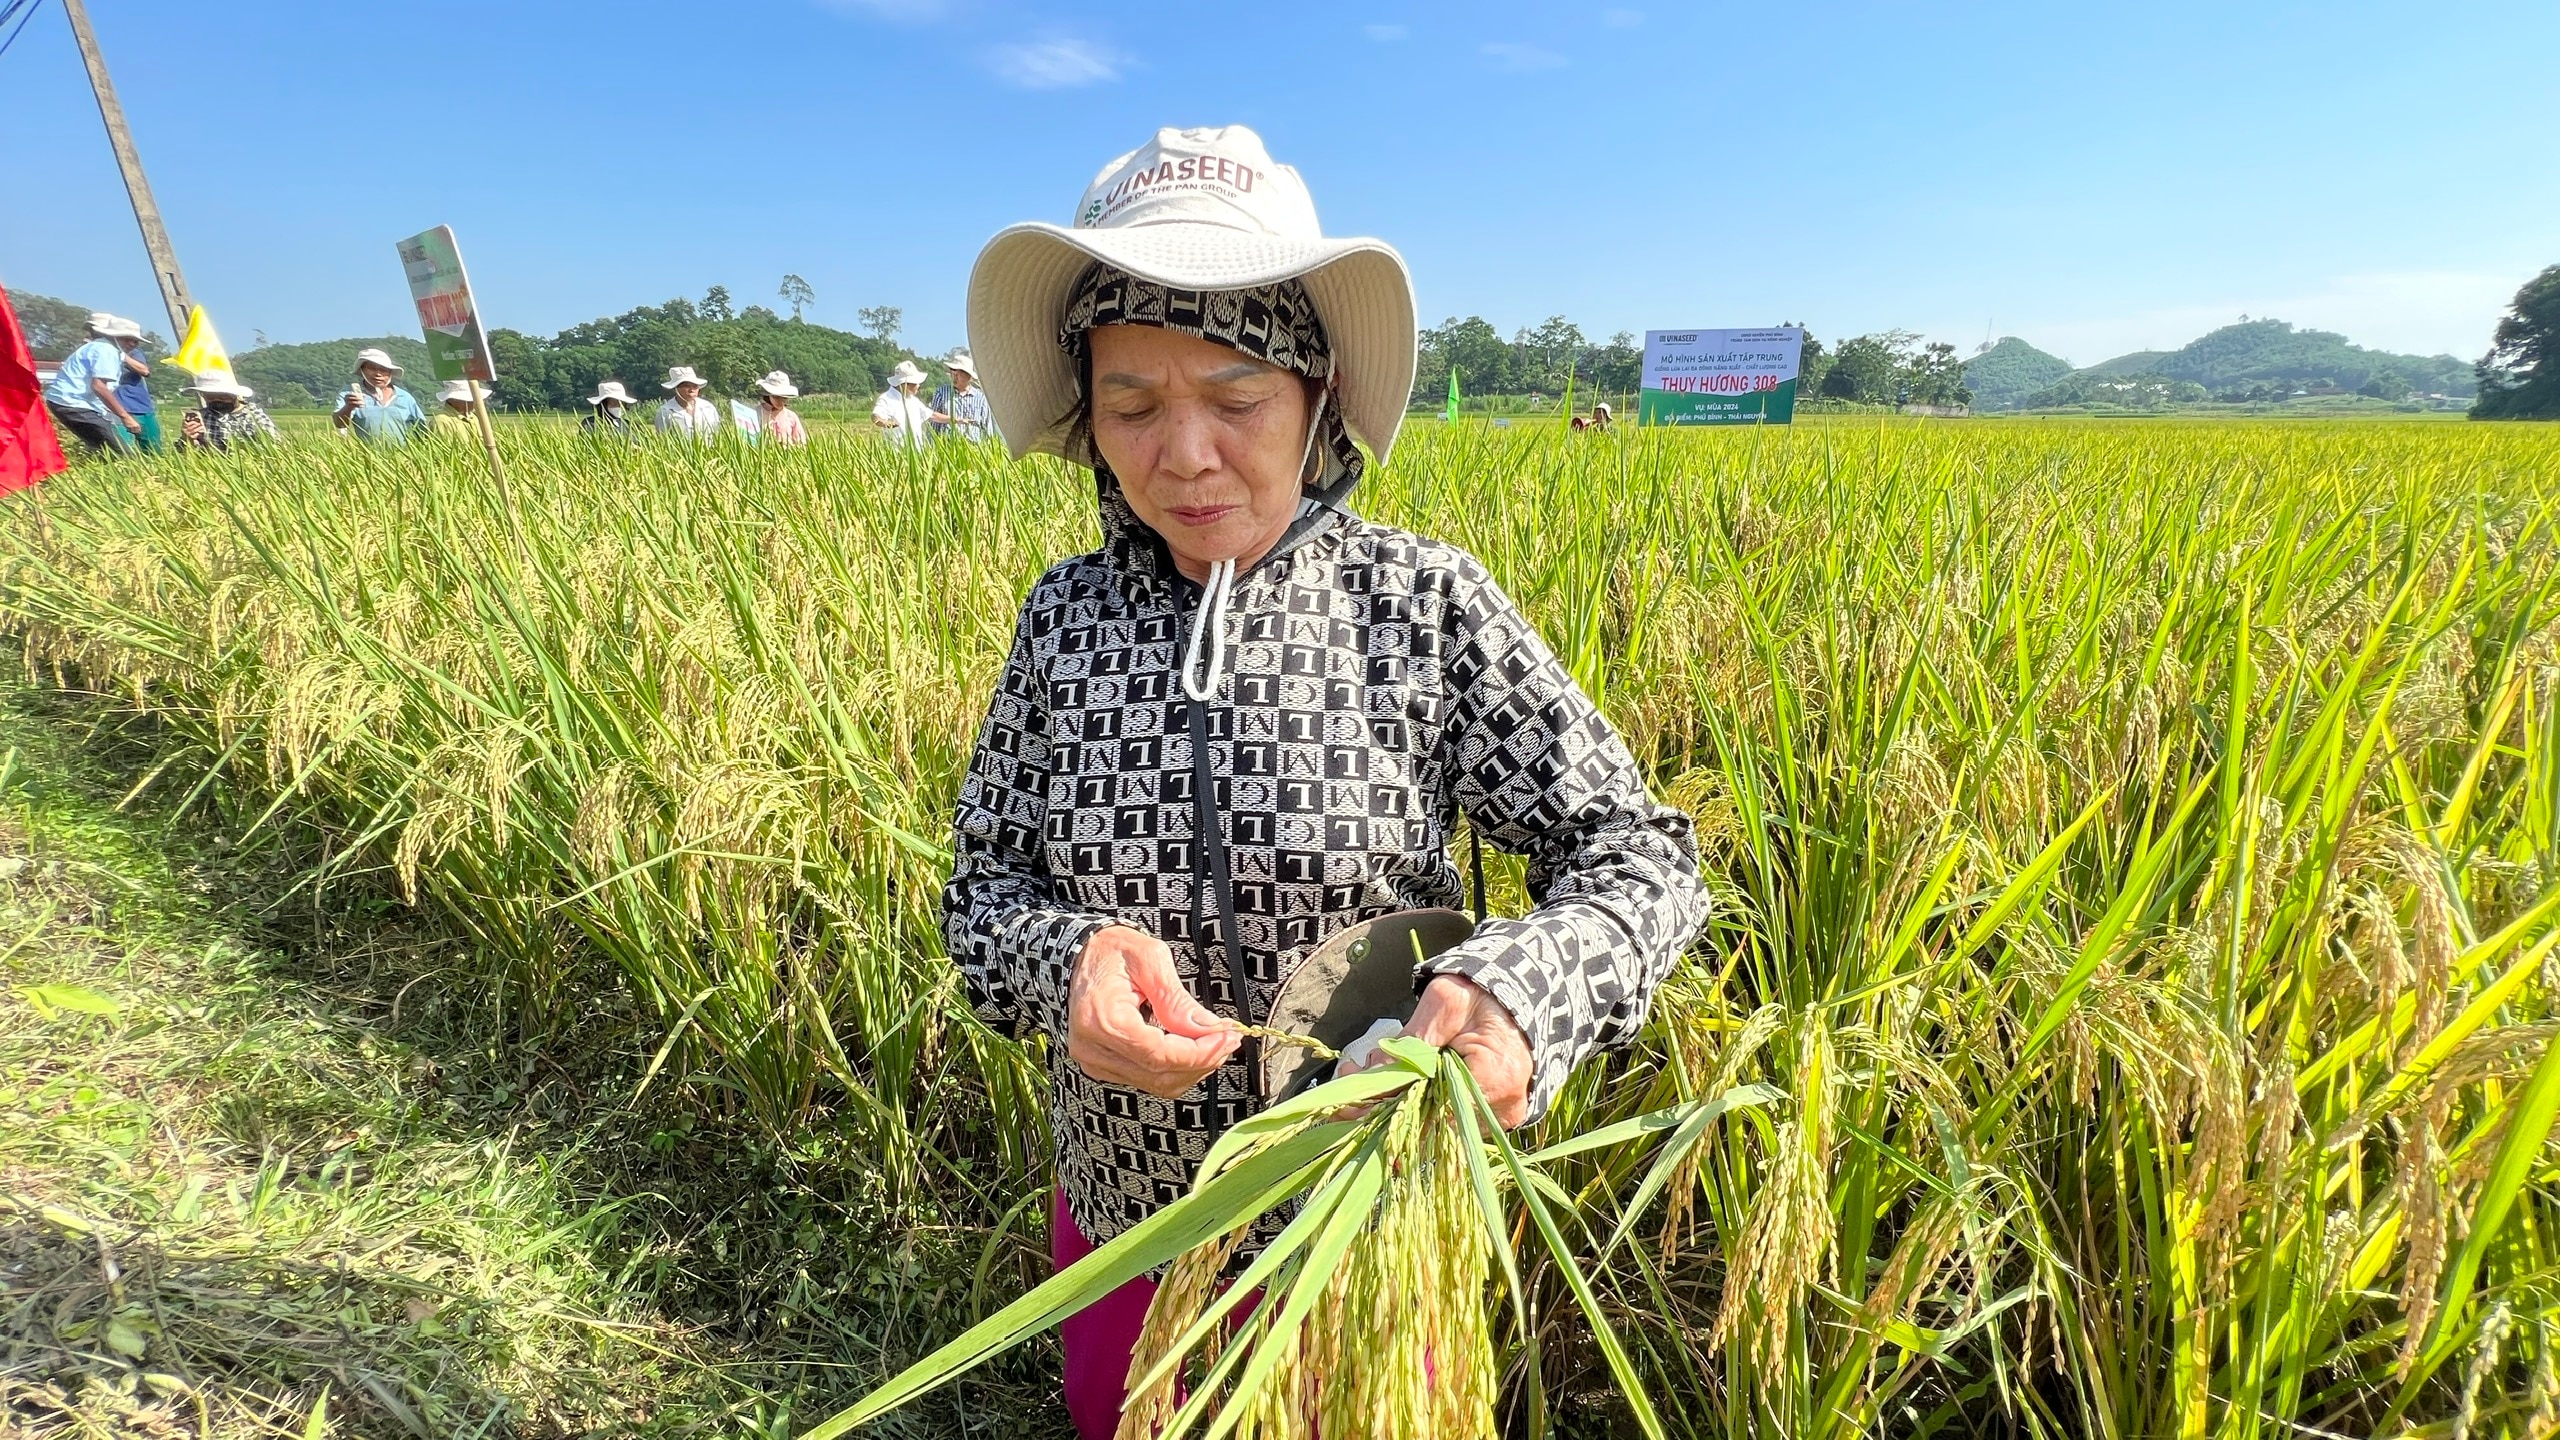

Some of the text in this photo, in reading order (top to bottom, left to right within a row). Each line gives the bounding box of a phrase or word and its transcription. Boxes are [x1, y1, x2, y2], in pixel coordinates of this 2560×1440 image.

[1098, 195, 1133, 225] MEMBER
[1134, 190, 1148, 200] OF
[1150, 184, 1172, 195] THE
[1174, 183, 1198, 191] PAN
[1200, 183, 1238, 198] GROUP
[1661, 351, 1784, 364] MÔ HÌNH SẢN XUẤT TẬP TRUNG
[1700, 374, 1748, 392] HƯƠNG
[1753, 375, 1778, 391] 308
